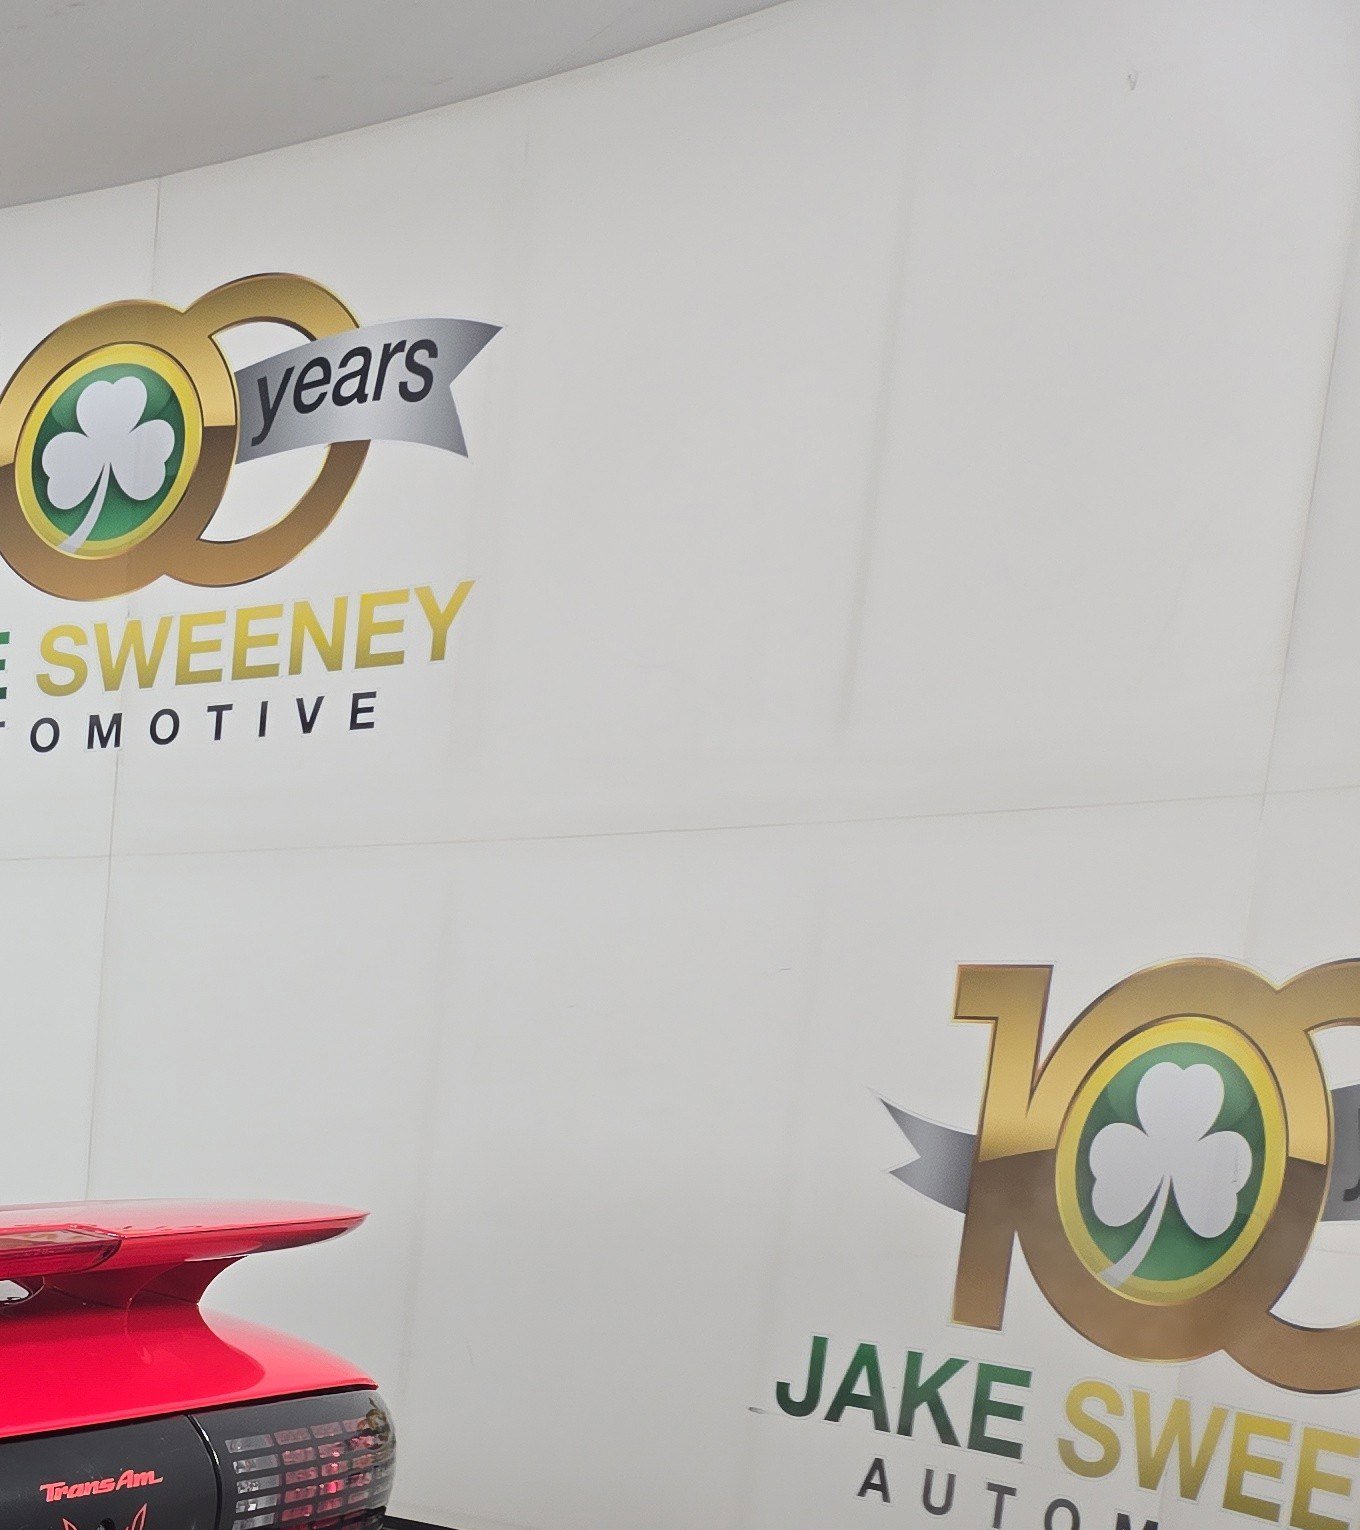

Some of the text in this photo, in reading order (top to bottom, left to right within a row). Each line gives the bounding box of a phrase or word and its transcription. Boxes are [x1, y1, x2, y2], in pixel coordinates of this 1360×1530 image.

[250, 336, 438, 447] years
[35, 580, 476, 698] SWEENEY
[775, 1334, 1033, 1461] JAKE
